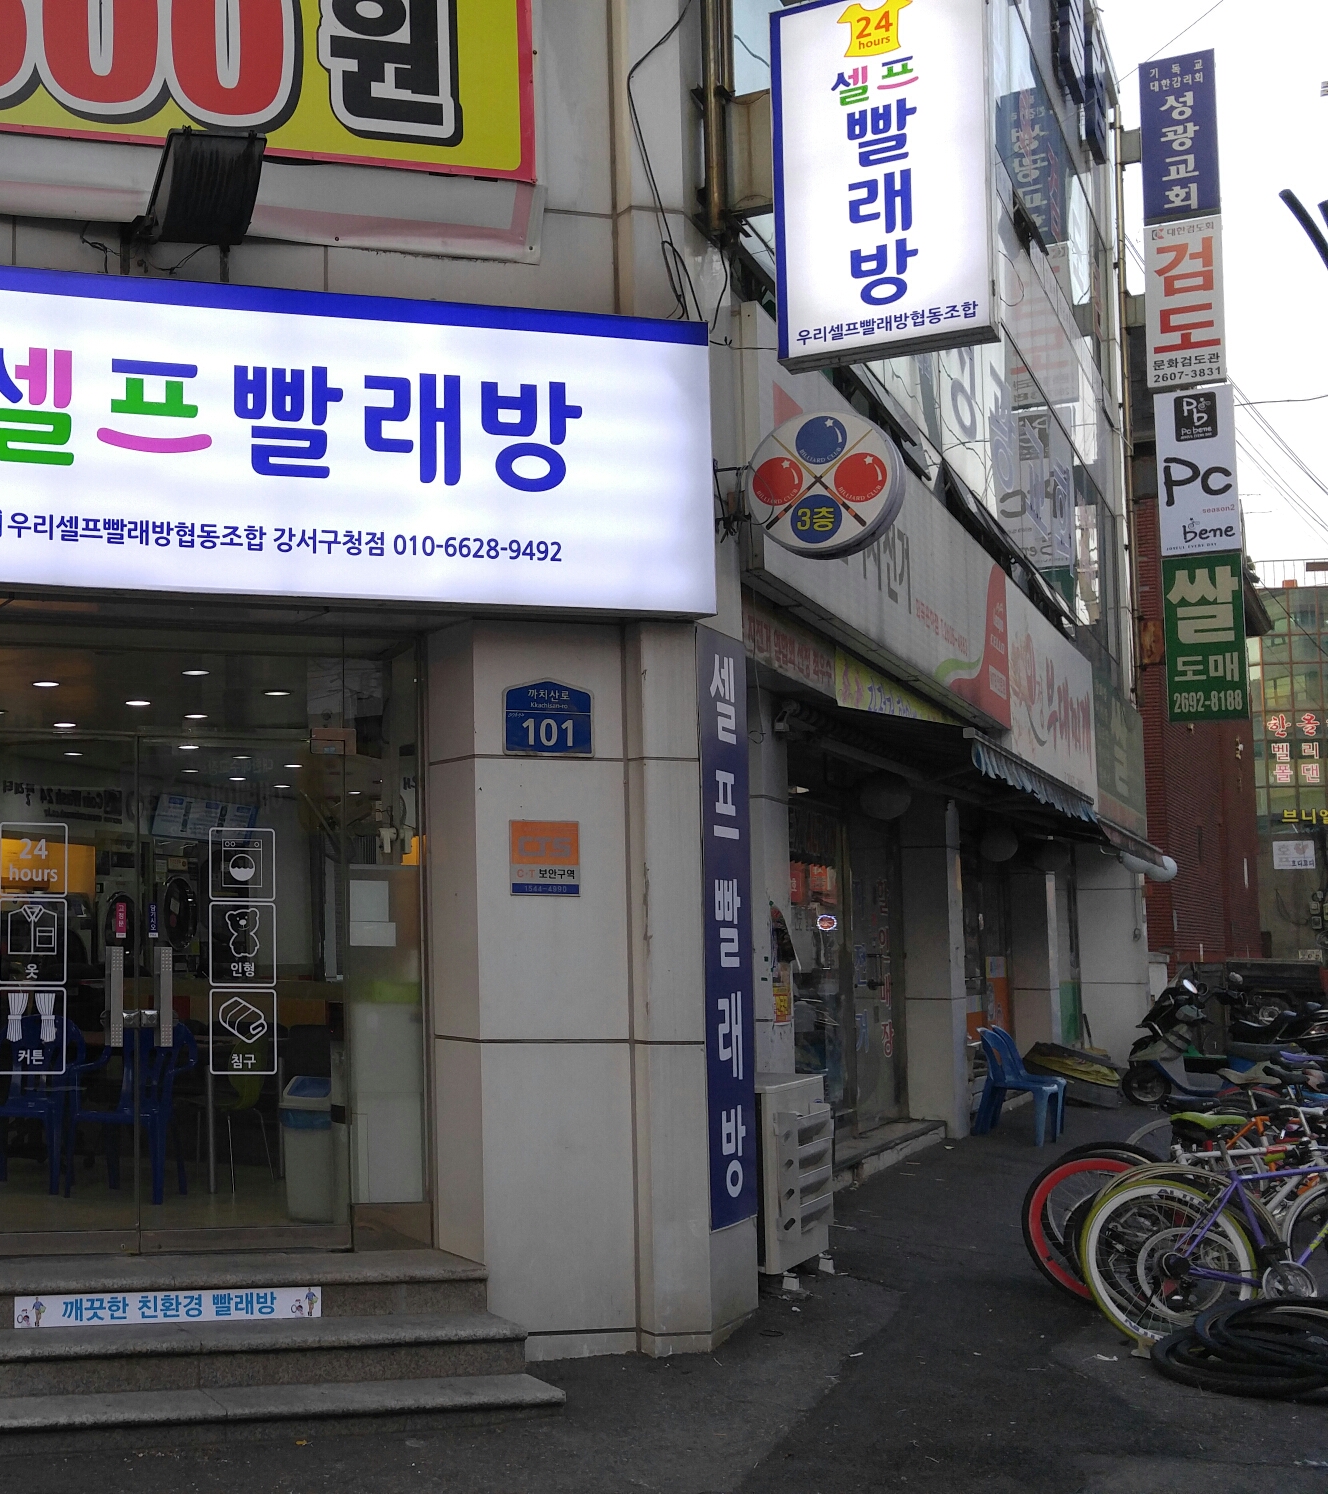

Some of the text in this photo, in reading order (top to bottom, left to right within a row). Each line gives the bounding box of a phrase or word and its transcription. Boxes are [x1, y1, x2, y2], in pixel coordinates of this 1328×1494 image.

[856, 10, 893, 39] 24
[858, 34, 891, 50] hours
[830, 55, 919, 106] 셀프
[1150, 71, 1204, 92] 대한감리회
[1159, 90, 1200, 210] 성광교회
[847, 97, 919, 305] 빨래방
[1153, 235, 1221, 355] 검도
[796, 301, 979, 345] 우리셀프빨래방협동조합
[1152, 352, 1220, 371] 문화검도관
[1153, 366, 1221, 384] 2607-3831
[799, 447, 842, 463] BILLIARD CLUB
[783, 488, 798, 502] CLUB
[838, 484, 882, 501] BILLIARD CLUB
[796, 507, 835, 531] 3층
[1202, 504, 1235, 514] season2
[7, 511, 562, 562] 우리셀프빨래방협동조합 강서구청점 010-6628-9492
[1182, 525, 1236, 543] bene
[1166, 564, 1239, 644] 쌀
[1173, 651, 1240, 682] 도매
[528, 689, 570, 702] 까치산로
[530, 701, 569, 709] Kkachisan-ro
[1173, 690, 1243, 713] 2692-8188
[522, 718, 574, 747] 101
[1267, 713, 1328, 738] 한올
[1272, 742, 1320, 762] 벨리
[18, 838, 49, 860] 24
[8, 863, 58, 884] hours
[539, 868, 575, 880] 보안구역
[709, 652, 746, 1199] 셀프빨래방
[24, 963, 40, 981] 옷
[230, 961, 256, 978] 인형
[17, 1048, 45, 1066] 커튼
[230, 1052, 257, 1070] 침구
[60, 1290, 278, 1322] 깨끗한 친환경 빨래방
